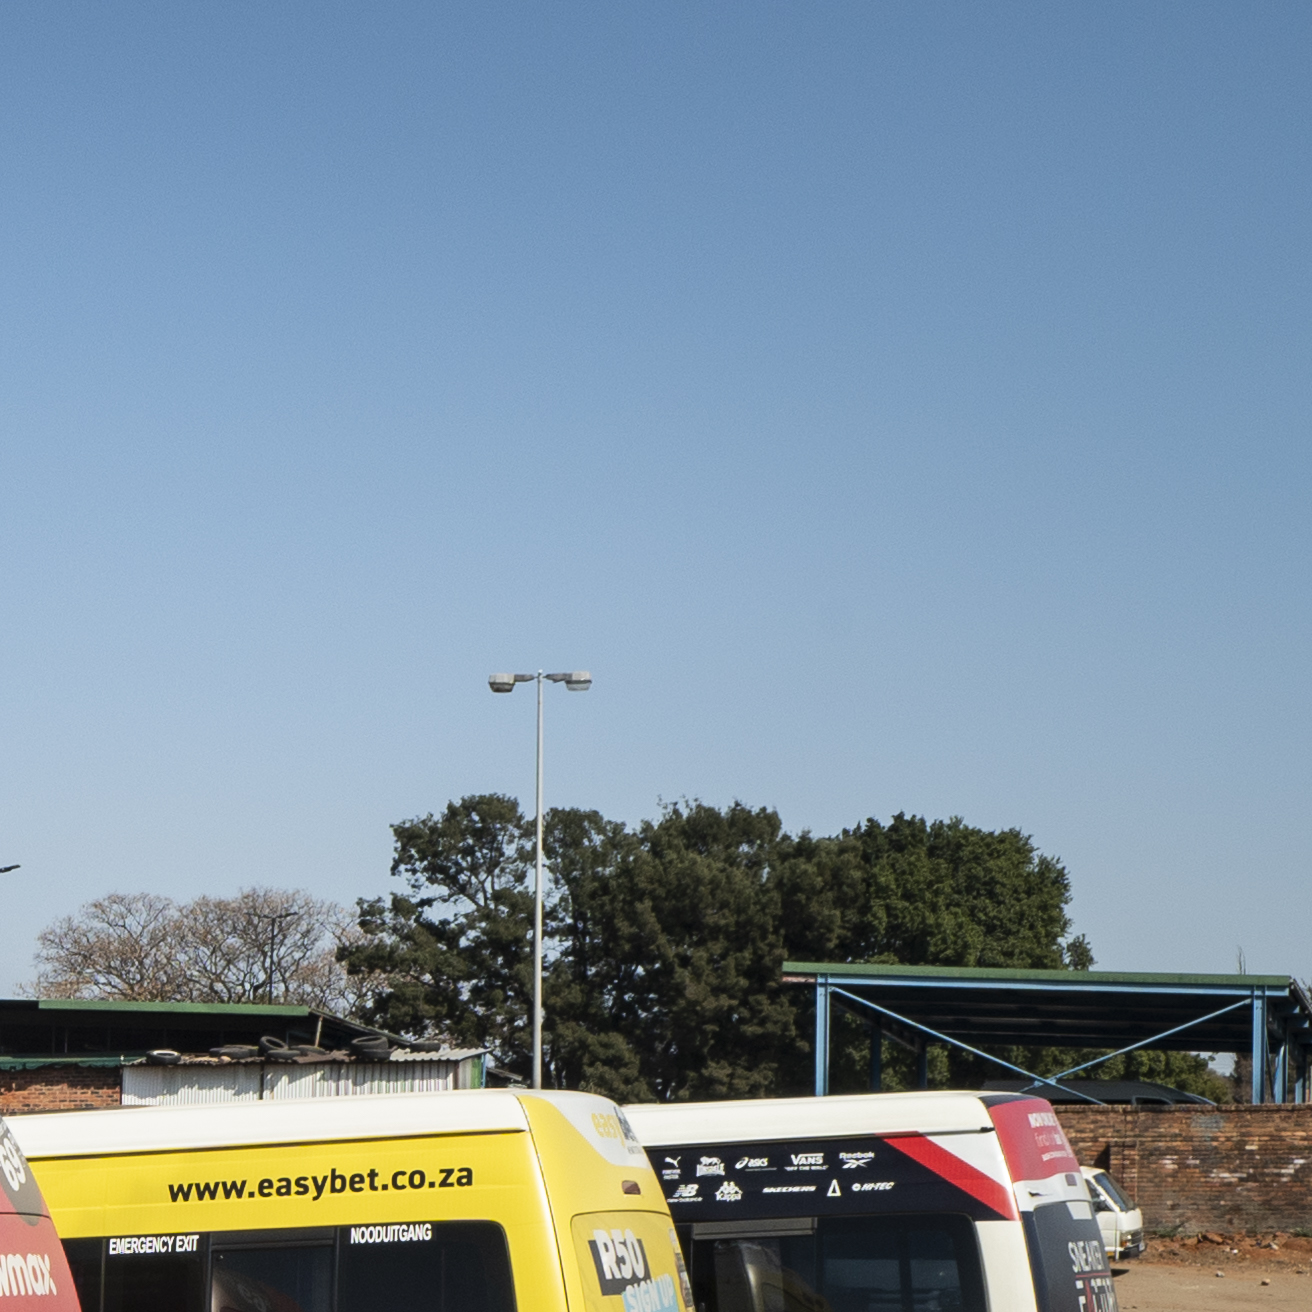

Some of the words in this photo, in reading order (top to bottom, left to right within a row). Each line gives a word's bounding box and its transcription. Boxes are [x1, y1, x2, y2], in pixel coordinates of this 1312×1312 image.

[791, 1152, 824, 1165] VANS
[167, 1165, 474, 1203] www.easybet.co.za
[109, 1235, 174, 1256] EMERGENCY
[176, 1234, 200, 1253] EXIT
[349, 1223, 433, 1245] NOODUITGANG
[593, 1229, 645, 1280] R50
[657, 1273, 674, 1308] UP
